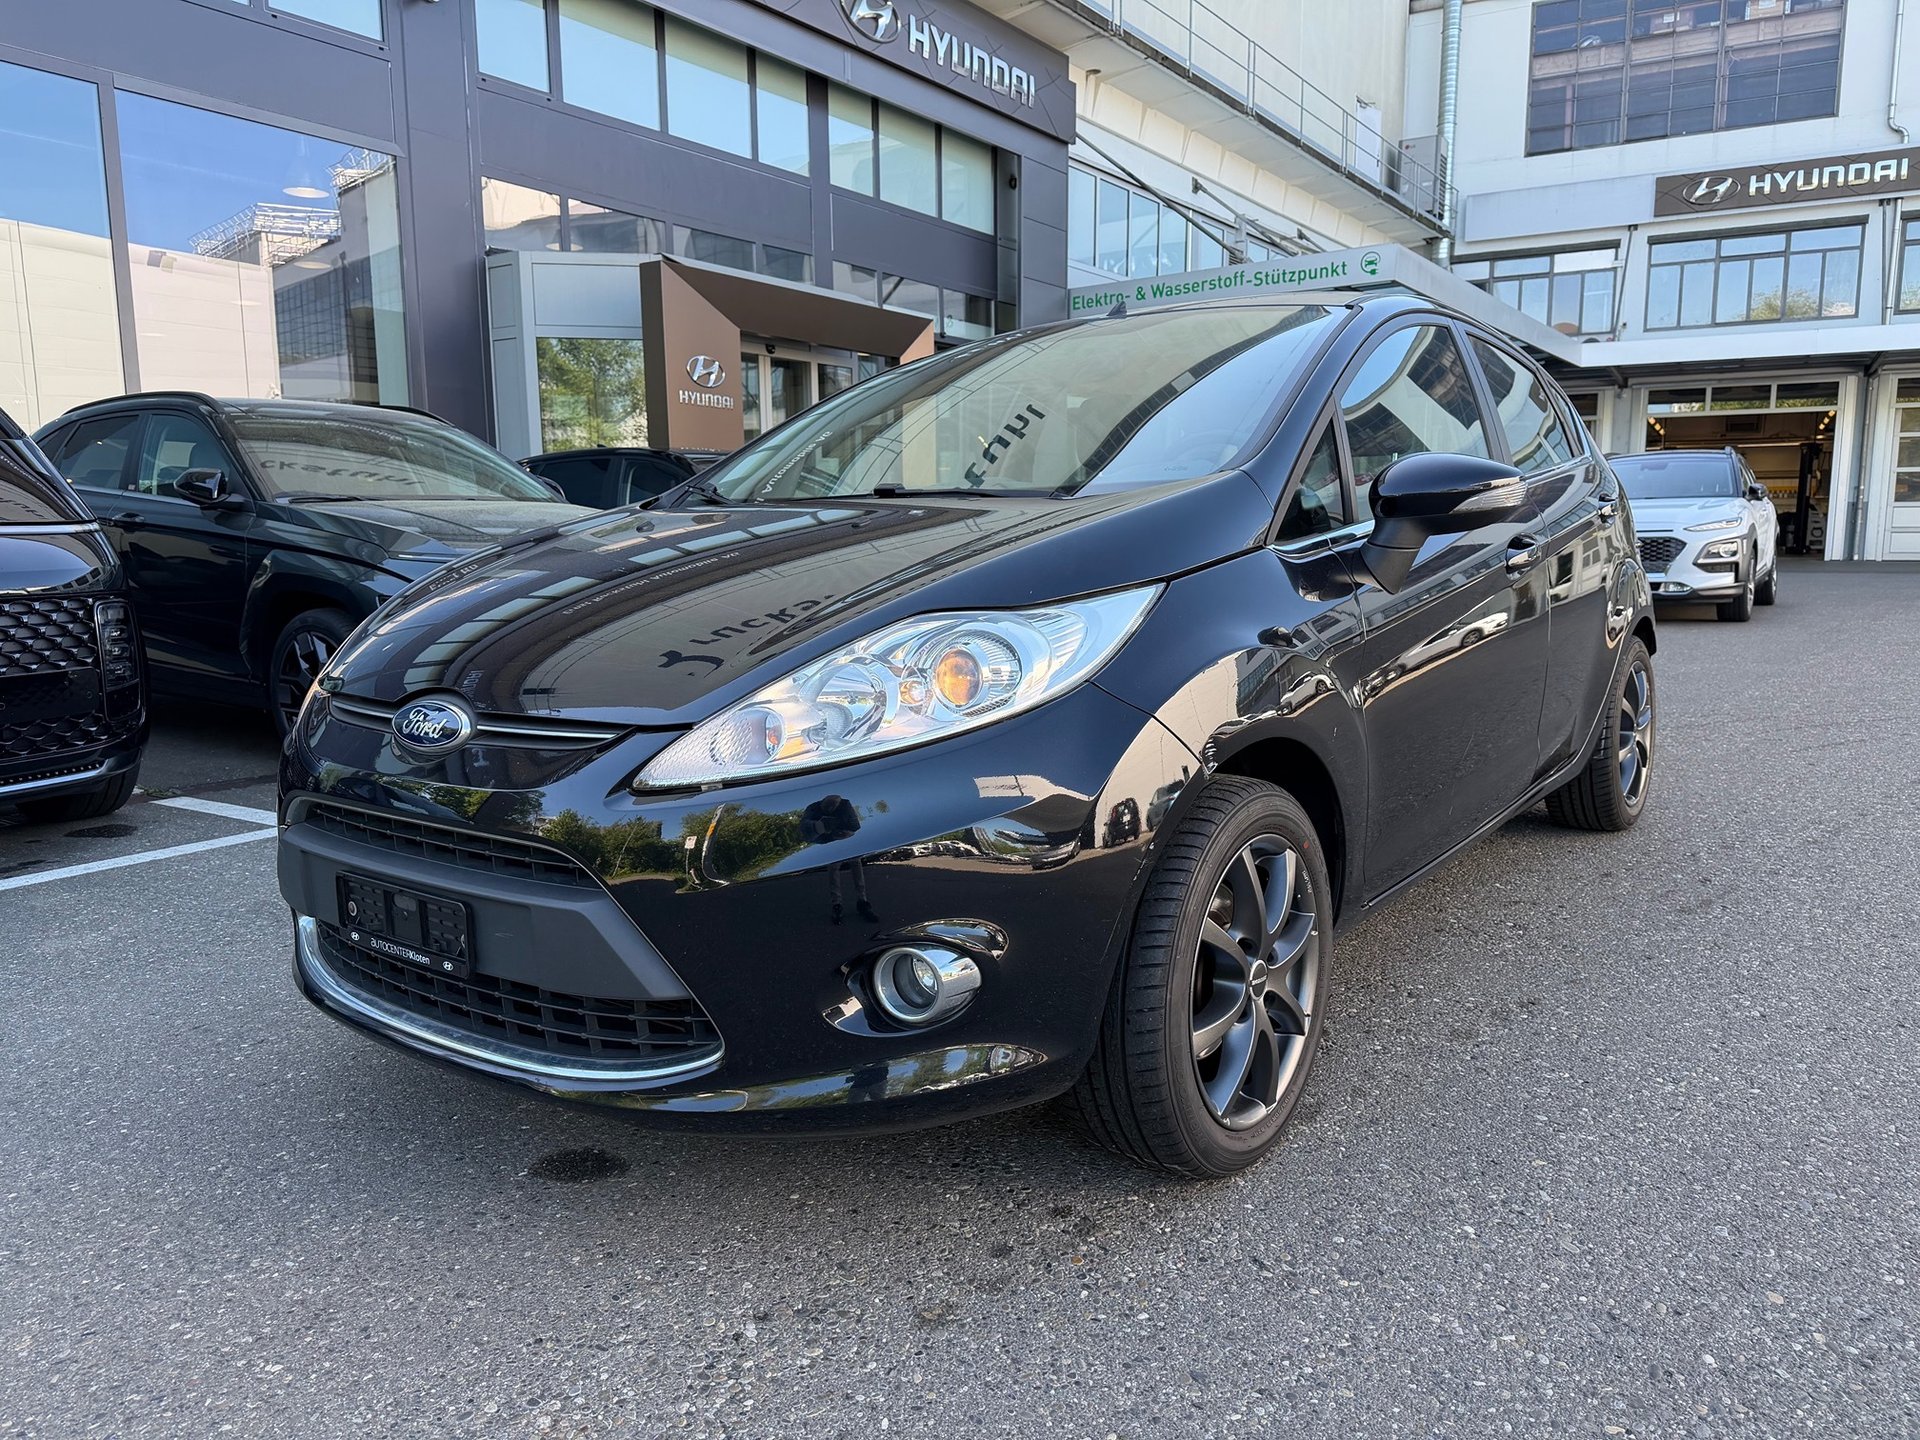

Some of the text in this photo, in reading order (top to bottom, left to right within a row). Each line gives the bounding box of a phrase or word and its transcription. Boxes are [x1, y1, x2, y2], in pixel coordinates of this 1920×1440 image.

[908, 13, 1036, 108] HYUNDAI
[1748, 157, 1910, 197] HYUNDAI
[1072, 260, 1348, 311] Elektro- & Wasserstoff-Stützpunkt
[679, 389, 734, 409] HYUNDAI
[402, 706, 449, 739] Ford
